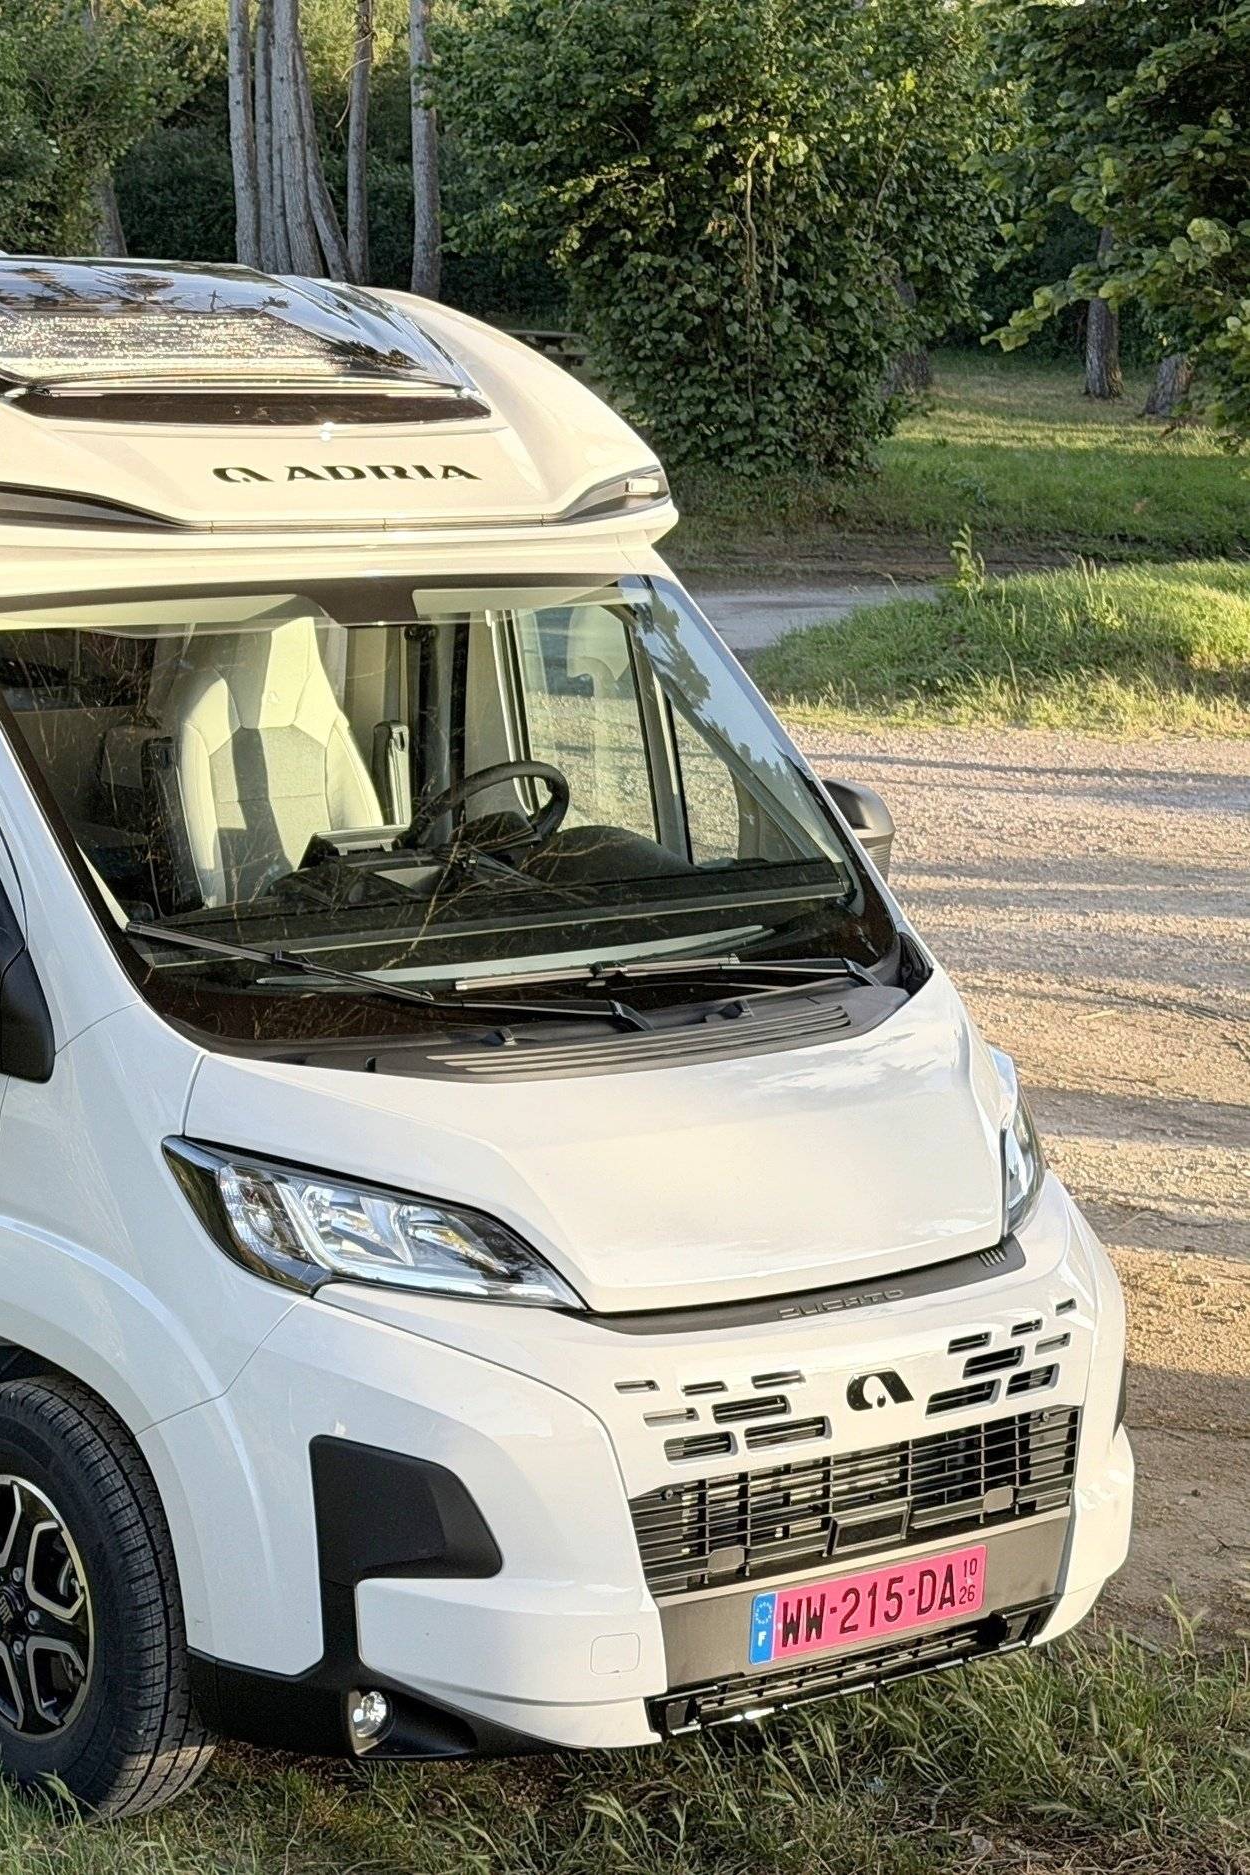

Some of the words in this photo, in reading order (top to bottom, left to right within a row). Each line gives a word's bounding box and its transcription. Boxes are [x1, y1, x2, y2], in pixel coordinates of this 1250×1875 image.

[286, 464, 483, 481] ADRIA
[963, 1557, 978, 1578] 10
[958, 1584, 976, 1605] 26
[782, 1563, 956, 1648] WW-215-DA
[758, 1631, 767, 1648] F
